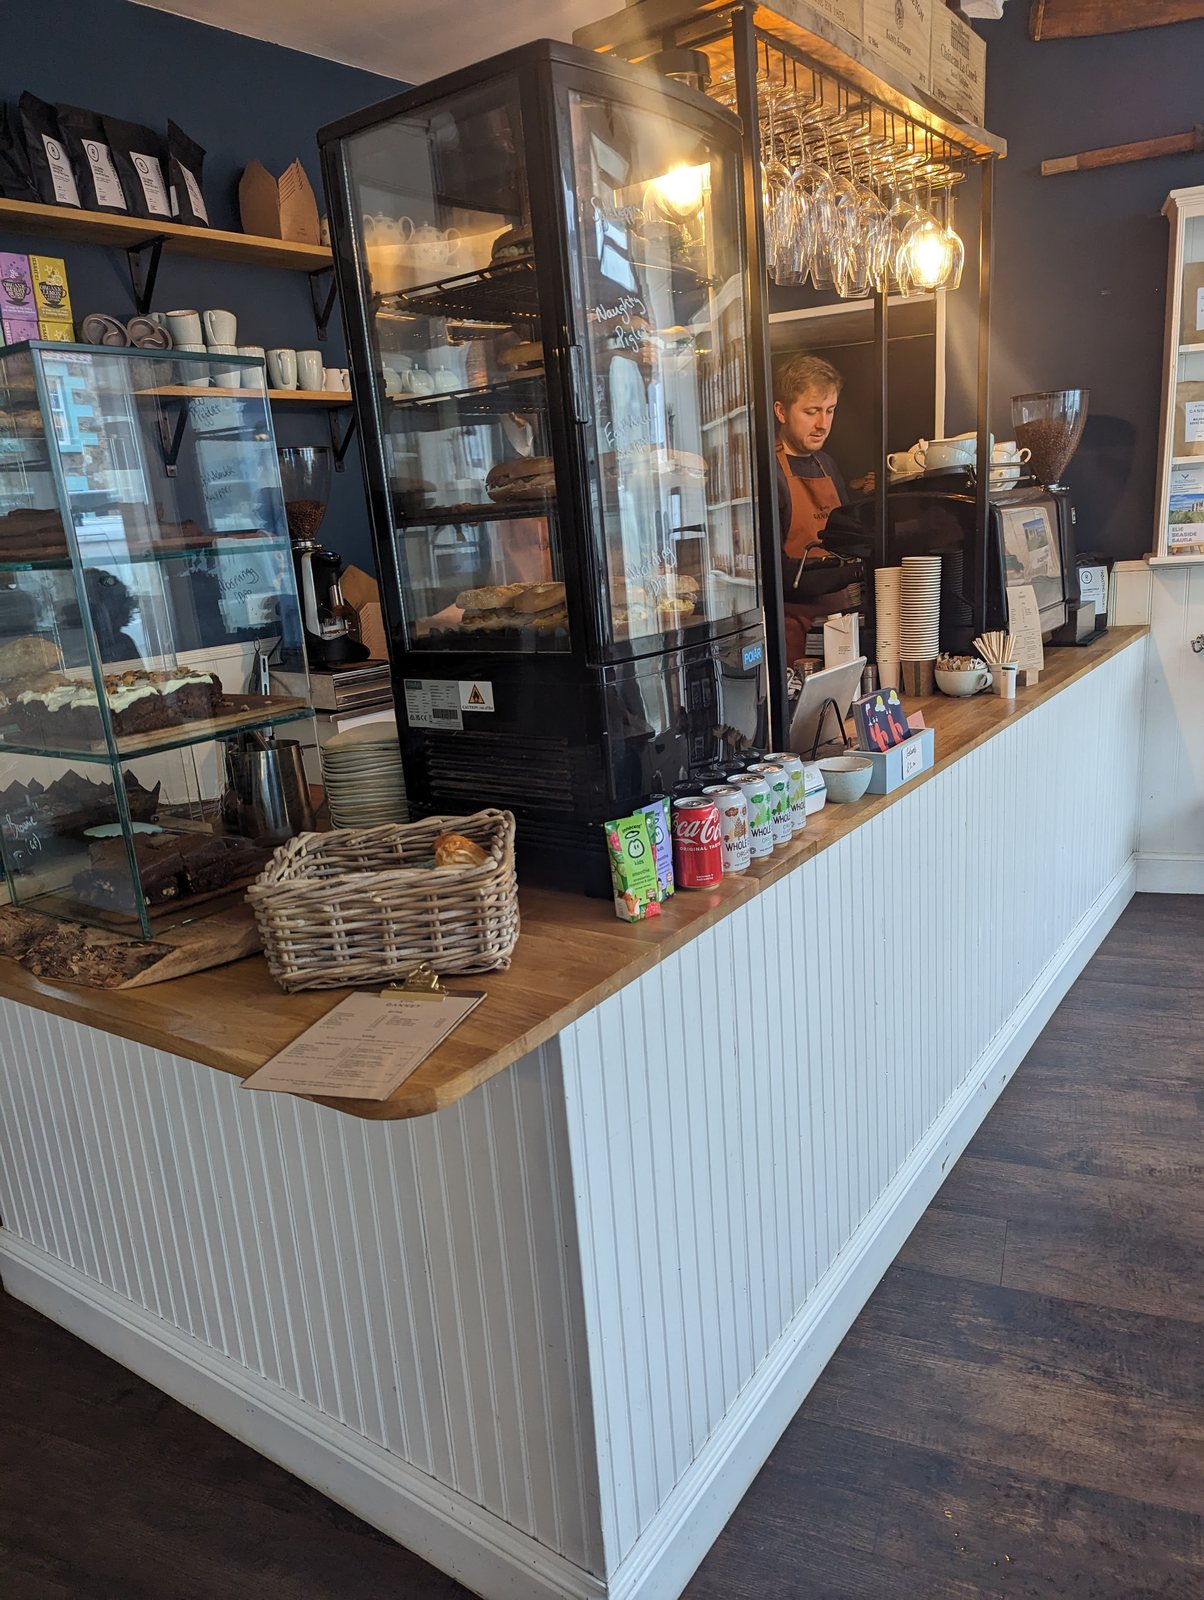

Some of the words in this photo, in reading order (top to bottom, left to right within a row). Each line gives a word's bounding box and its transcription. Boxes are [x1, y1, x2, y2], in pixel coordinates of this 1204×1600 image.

[595, 296, 646, 324] Naughty
[744, 647, 762, 665] POLAR
[725, 839, 748, 852] WHOLE
